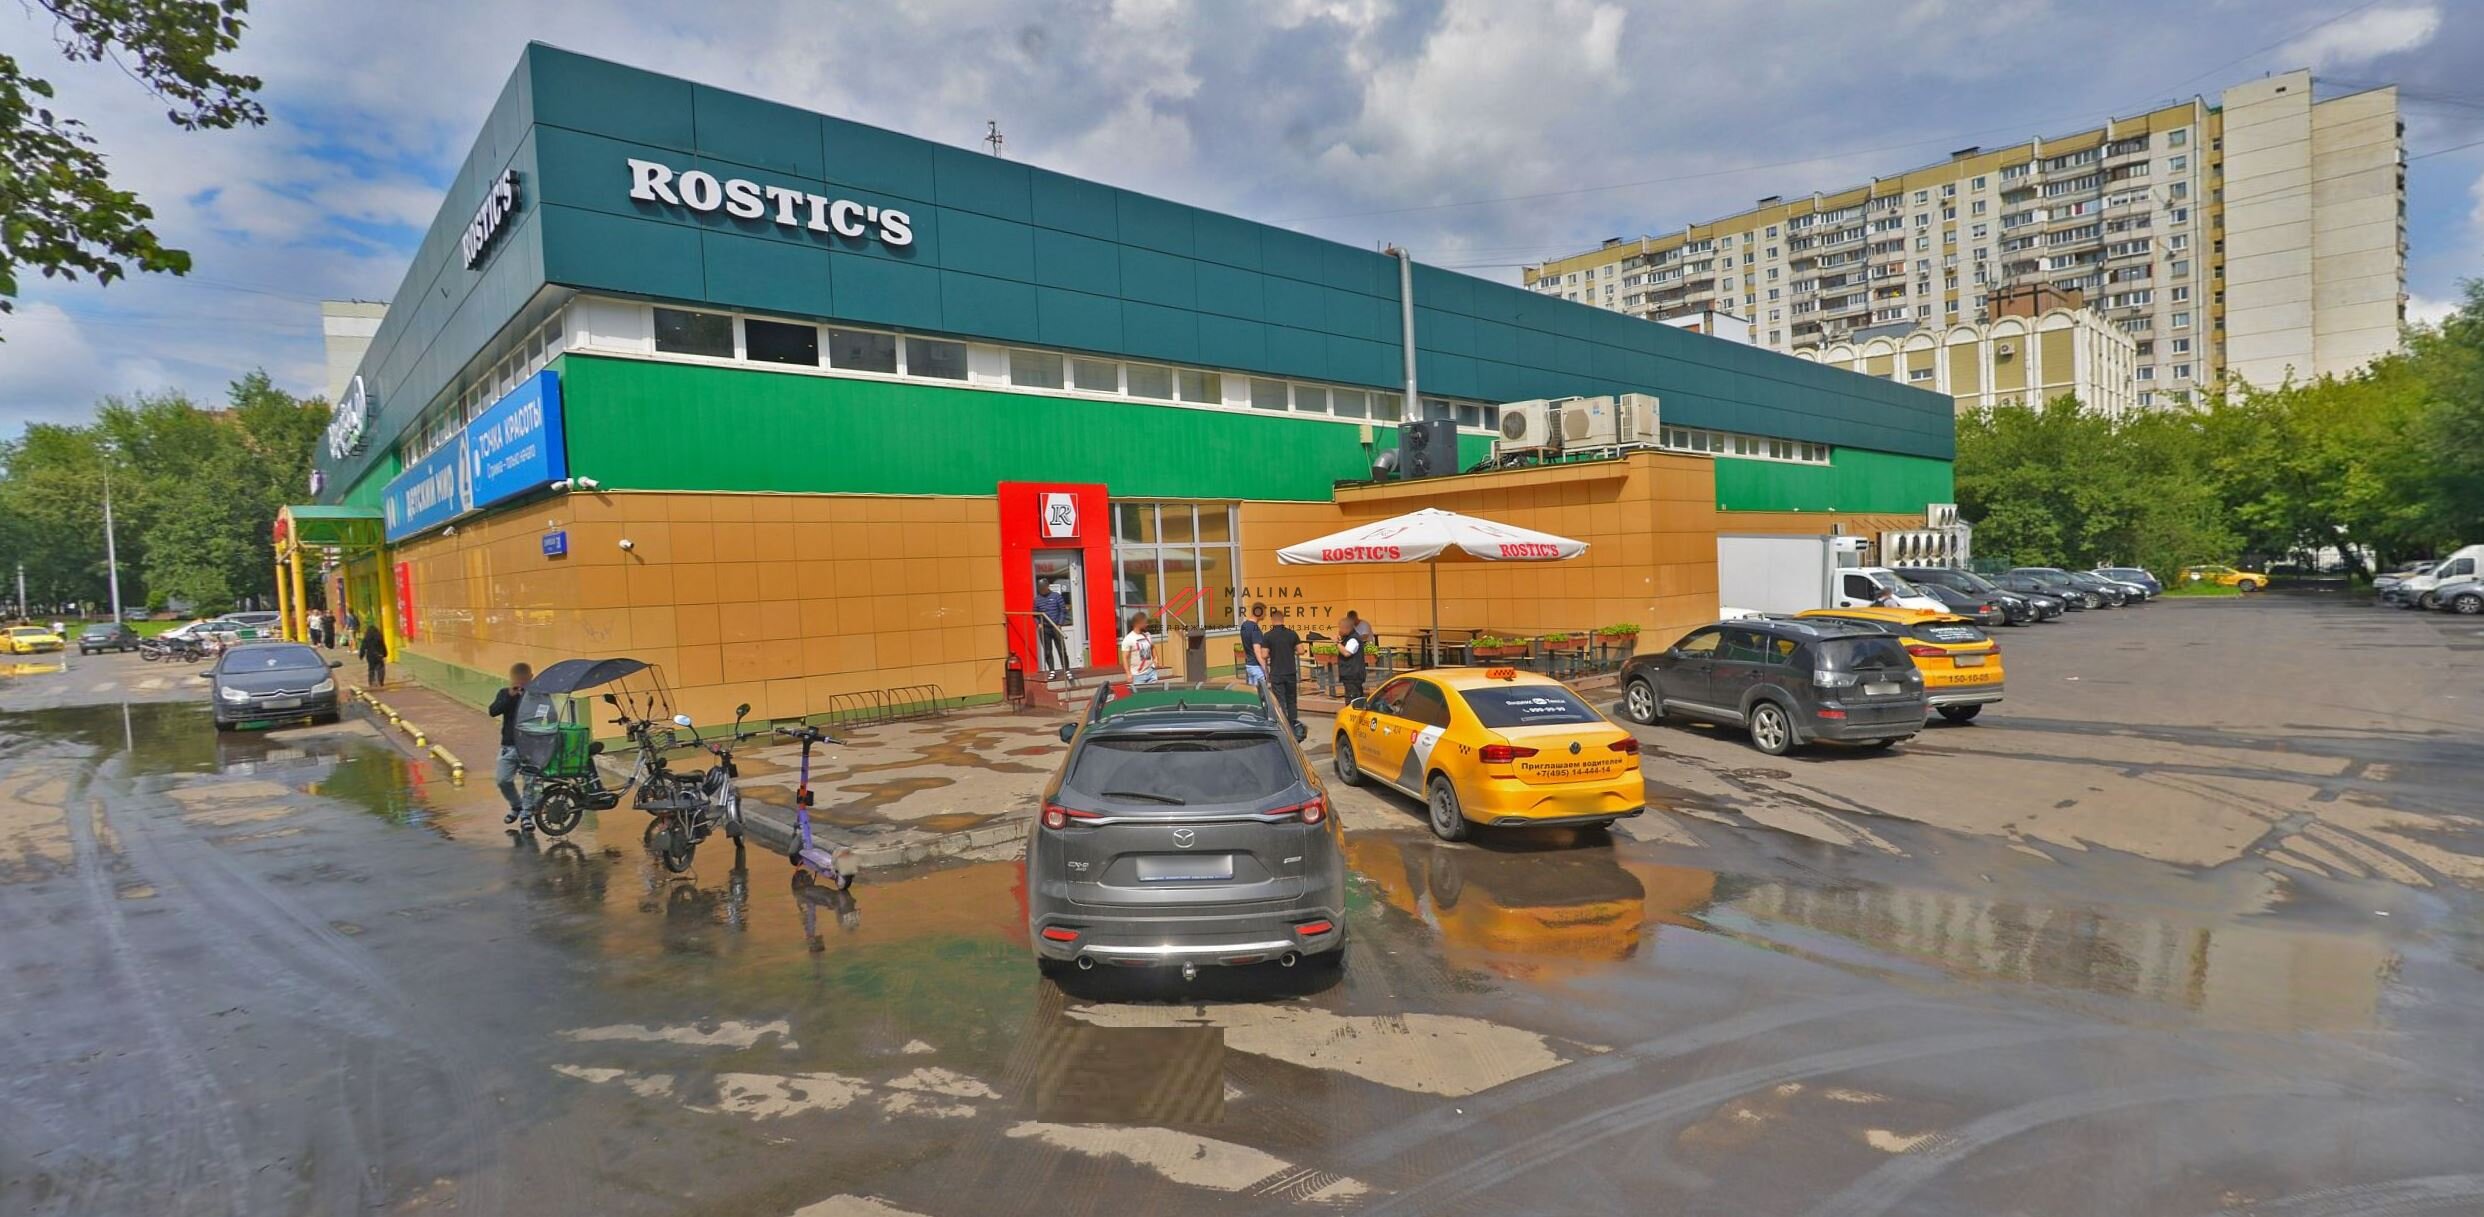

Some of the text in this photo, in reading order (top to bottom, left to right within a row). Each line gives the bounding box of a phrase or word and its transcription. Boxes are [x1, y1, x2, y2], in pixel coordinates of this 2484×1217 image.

[627, 158, 914, 245] ROSTIC'S
[462, 168, 513, 269] ROSTIC'S
[479, 396, 542, 459] ТОЧКА КРАСОТЫ
[1050, 504, 1072, 526] R
[1321, 546, 1401, 561] ROSTIC'S
[1499, 544, 1559, 557] ROSTIC'S
[1521, 758, 1622, 771] Приглашаем водителей
[1536, 766, 1611, 777] +7(495) 14-444-14
